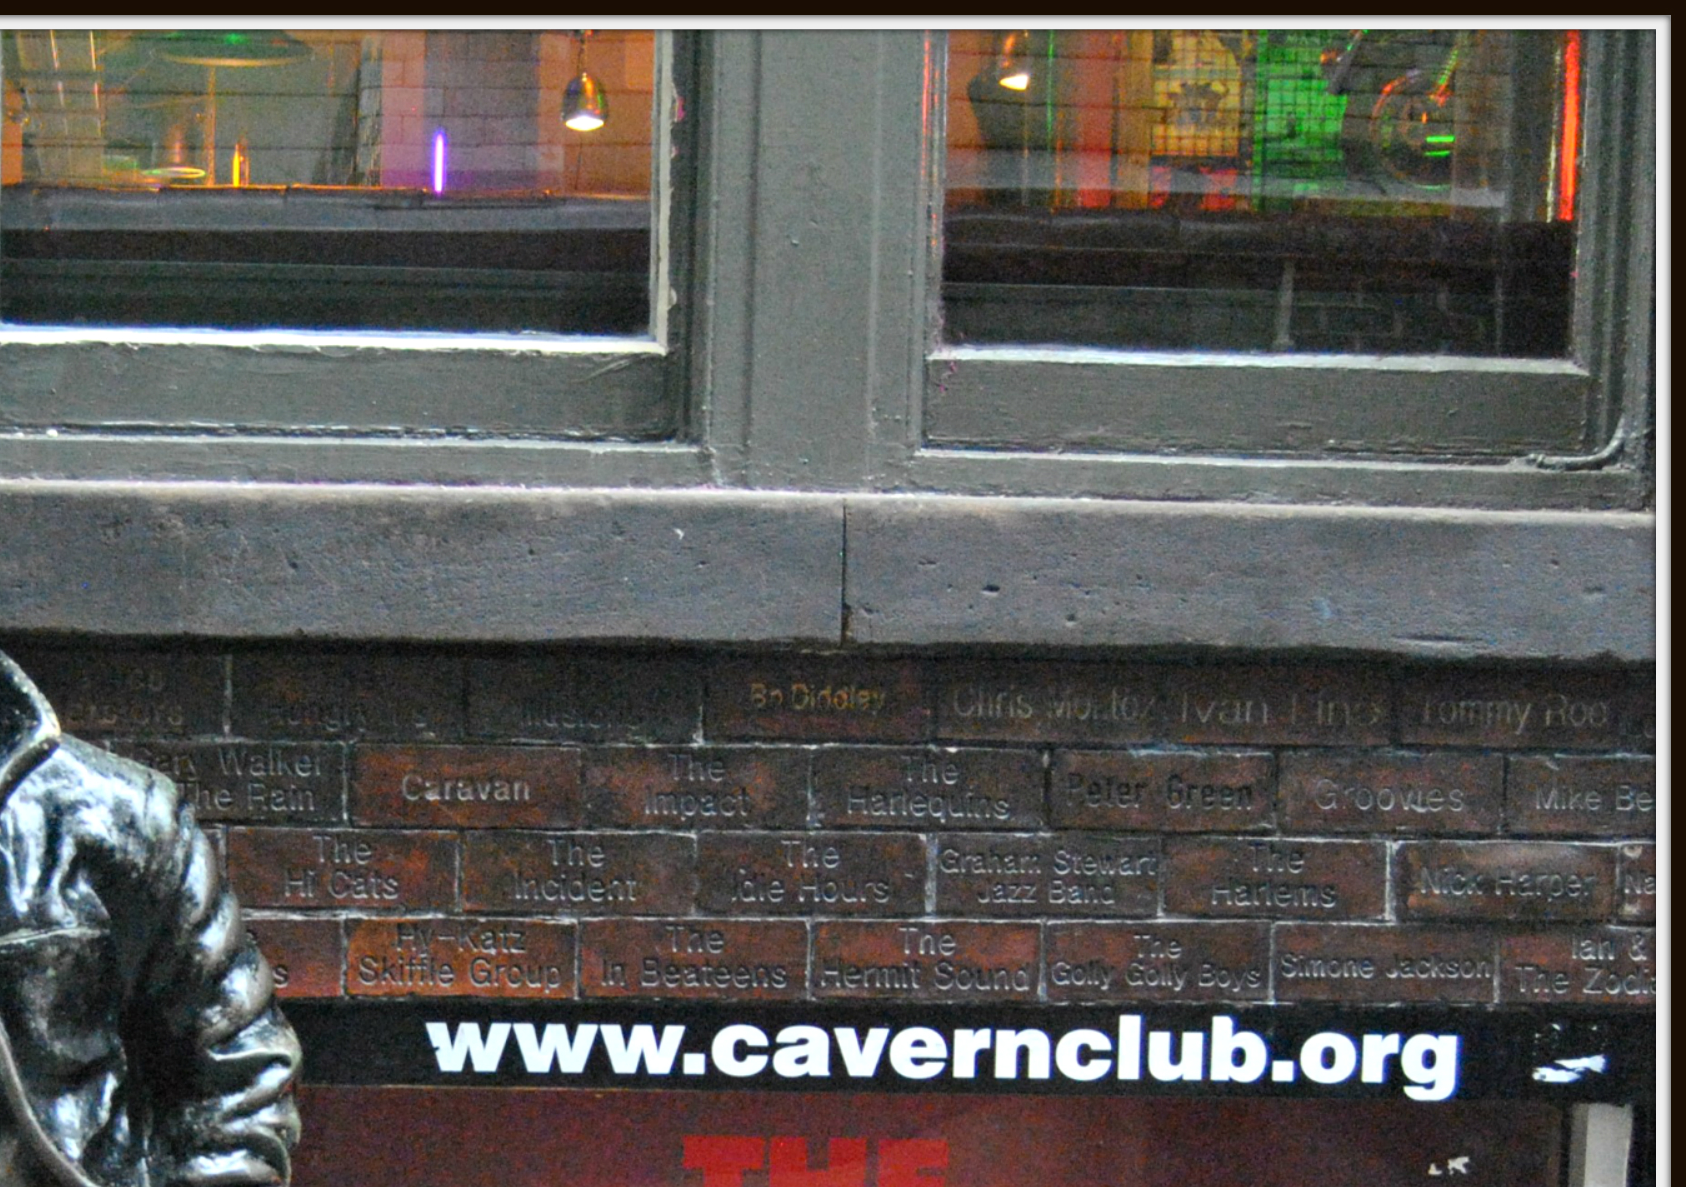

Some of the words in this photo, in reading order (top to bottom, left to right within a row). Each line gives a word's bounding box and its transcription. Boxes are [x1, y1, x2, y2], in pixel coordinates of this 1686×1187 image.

[790, 681, 886, 715] Diddley
[953, 686, 1033, 719] Chris
[1181, 692, 1268, 724] Ivan
[217, 747, 322, 778] Walker
[667, 753, 726, 783] The
[900, 755, 959, 786] The
[246, 782, 315, 812] Rain
[400, 773, 531, 804] Caravan
[643, 786, 750, 821] Impact
[846, 785, 1012, 823] Harlequins
[1064, 772, 1148, 810] Peter
[1165, 772, 1253, 811] Green
[1313, 777, 1465, 814] Groovies
[1534, 786, 1602, 811] Mike
[313, 835, 373, 865] The
[547, 838, 607, 869] The
[781, 838, 841, 869] The
[938, 848, 1042, 875] Graham
[1052, 848, 1157, 877] Stewart
[1249, 845, 1306, 874] The
[283, 868, 314, 898] Hi
[326, 870, 400, 899] Cats
[514, 874, 637, 903] Incident
[797, 872, 890, 904] Hours
[976, 880, 1038, 905] Jazz
[1047, 879, 1116, 905] Band
[1209, 881, 1338, 909] Harlems
[1419, 866, 1484, 897] Nick
[1494, 872, 1598, 902] Harper
[665, 925, 727, 955] The
[899, 927, 957, 957] The
[1133, 934, 1183, 960] The
[1570, 934, 1616, 960] Ian
[1628, 934, 1648, 961] &
[358, 955, 456, 987] Skiffle
[468, 957, 561, 994] Group
[600, 958, 626, 988] In
[640, 957, 788, 989] Beateens
[819, 959, 920, 990] Hermit
[933, 960, 1030, 993] Sound
[1050, 960, 1116, 991] Golly
[1125, 961, 1190, 992] Golly
[1197, 962, 1261, 993] Boys
[1280, 952, 1376, 980] Simone
[1385, 955, 1492, 980] Jackson
[1515, 966, 1570, 995] The
[426, 1014, 1460, 1100] www.cavernclub.org
